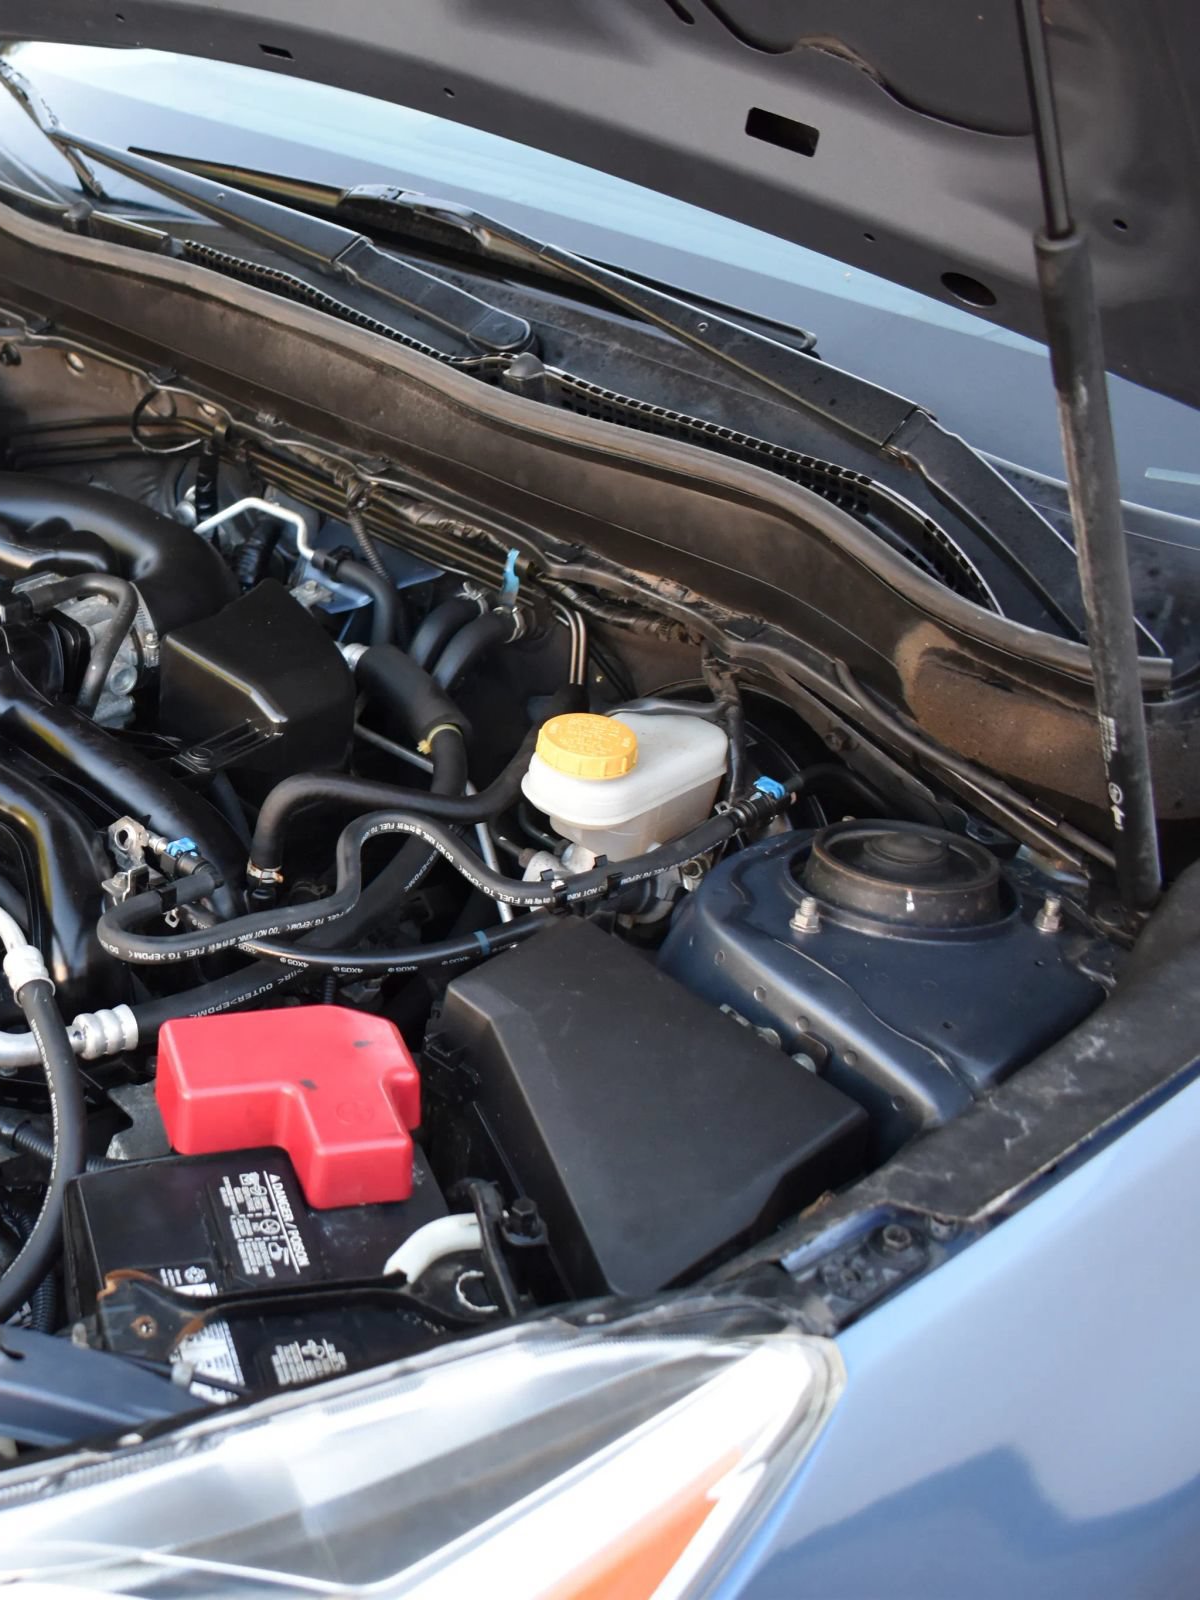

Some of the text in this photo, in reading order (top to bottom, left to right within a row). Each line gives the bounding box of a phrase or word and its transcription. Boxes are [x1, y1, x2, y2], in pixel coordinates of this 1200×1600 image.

[378, 822, 395, 830] FUEL
[445, 852, 454, 863] DO
[483, 886, 495, 896] TG
[498, 892, 520, 904] FUEL
[566, 892, 582, 901] KIN
[254, 929, 268, 939] NOT
[268, 926, 279, 936] DO
[183, 947, 205, 957] FUEL
[272, 1182, 295, 1222] DANGER
[287, 1229, 311, 1268] POISON
